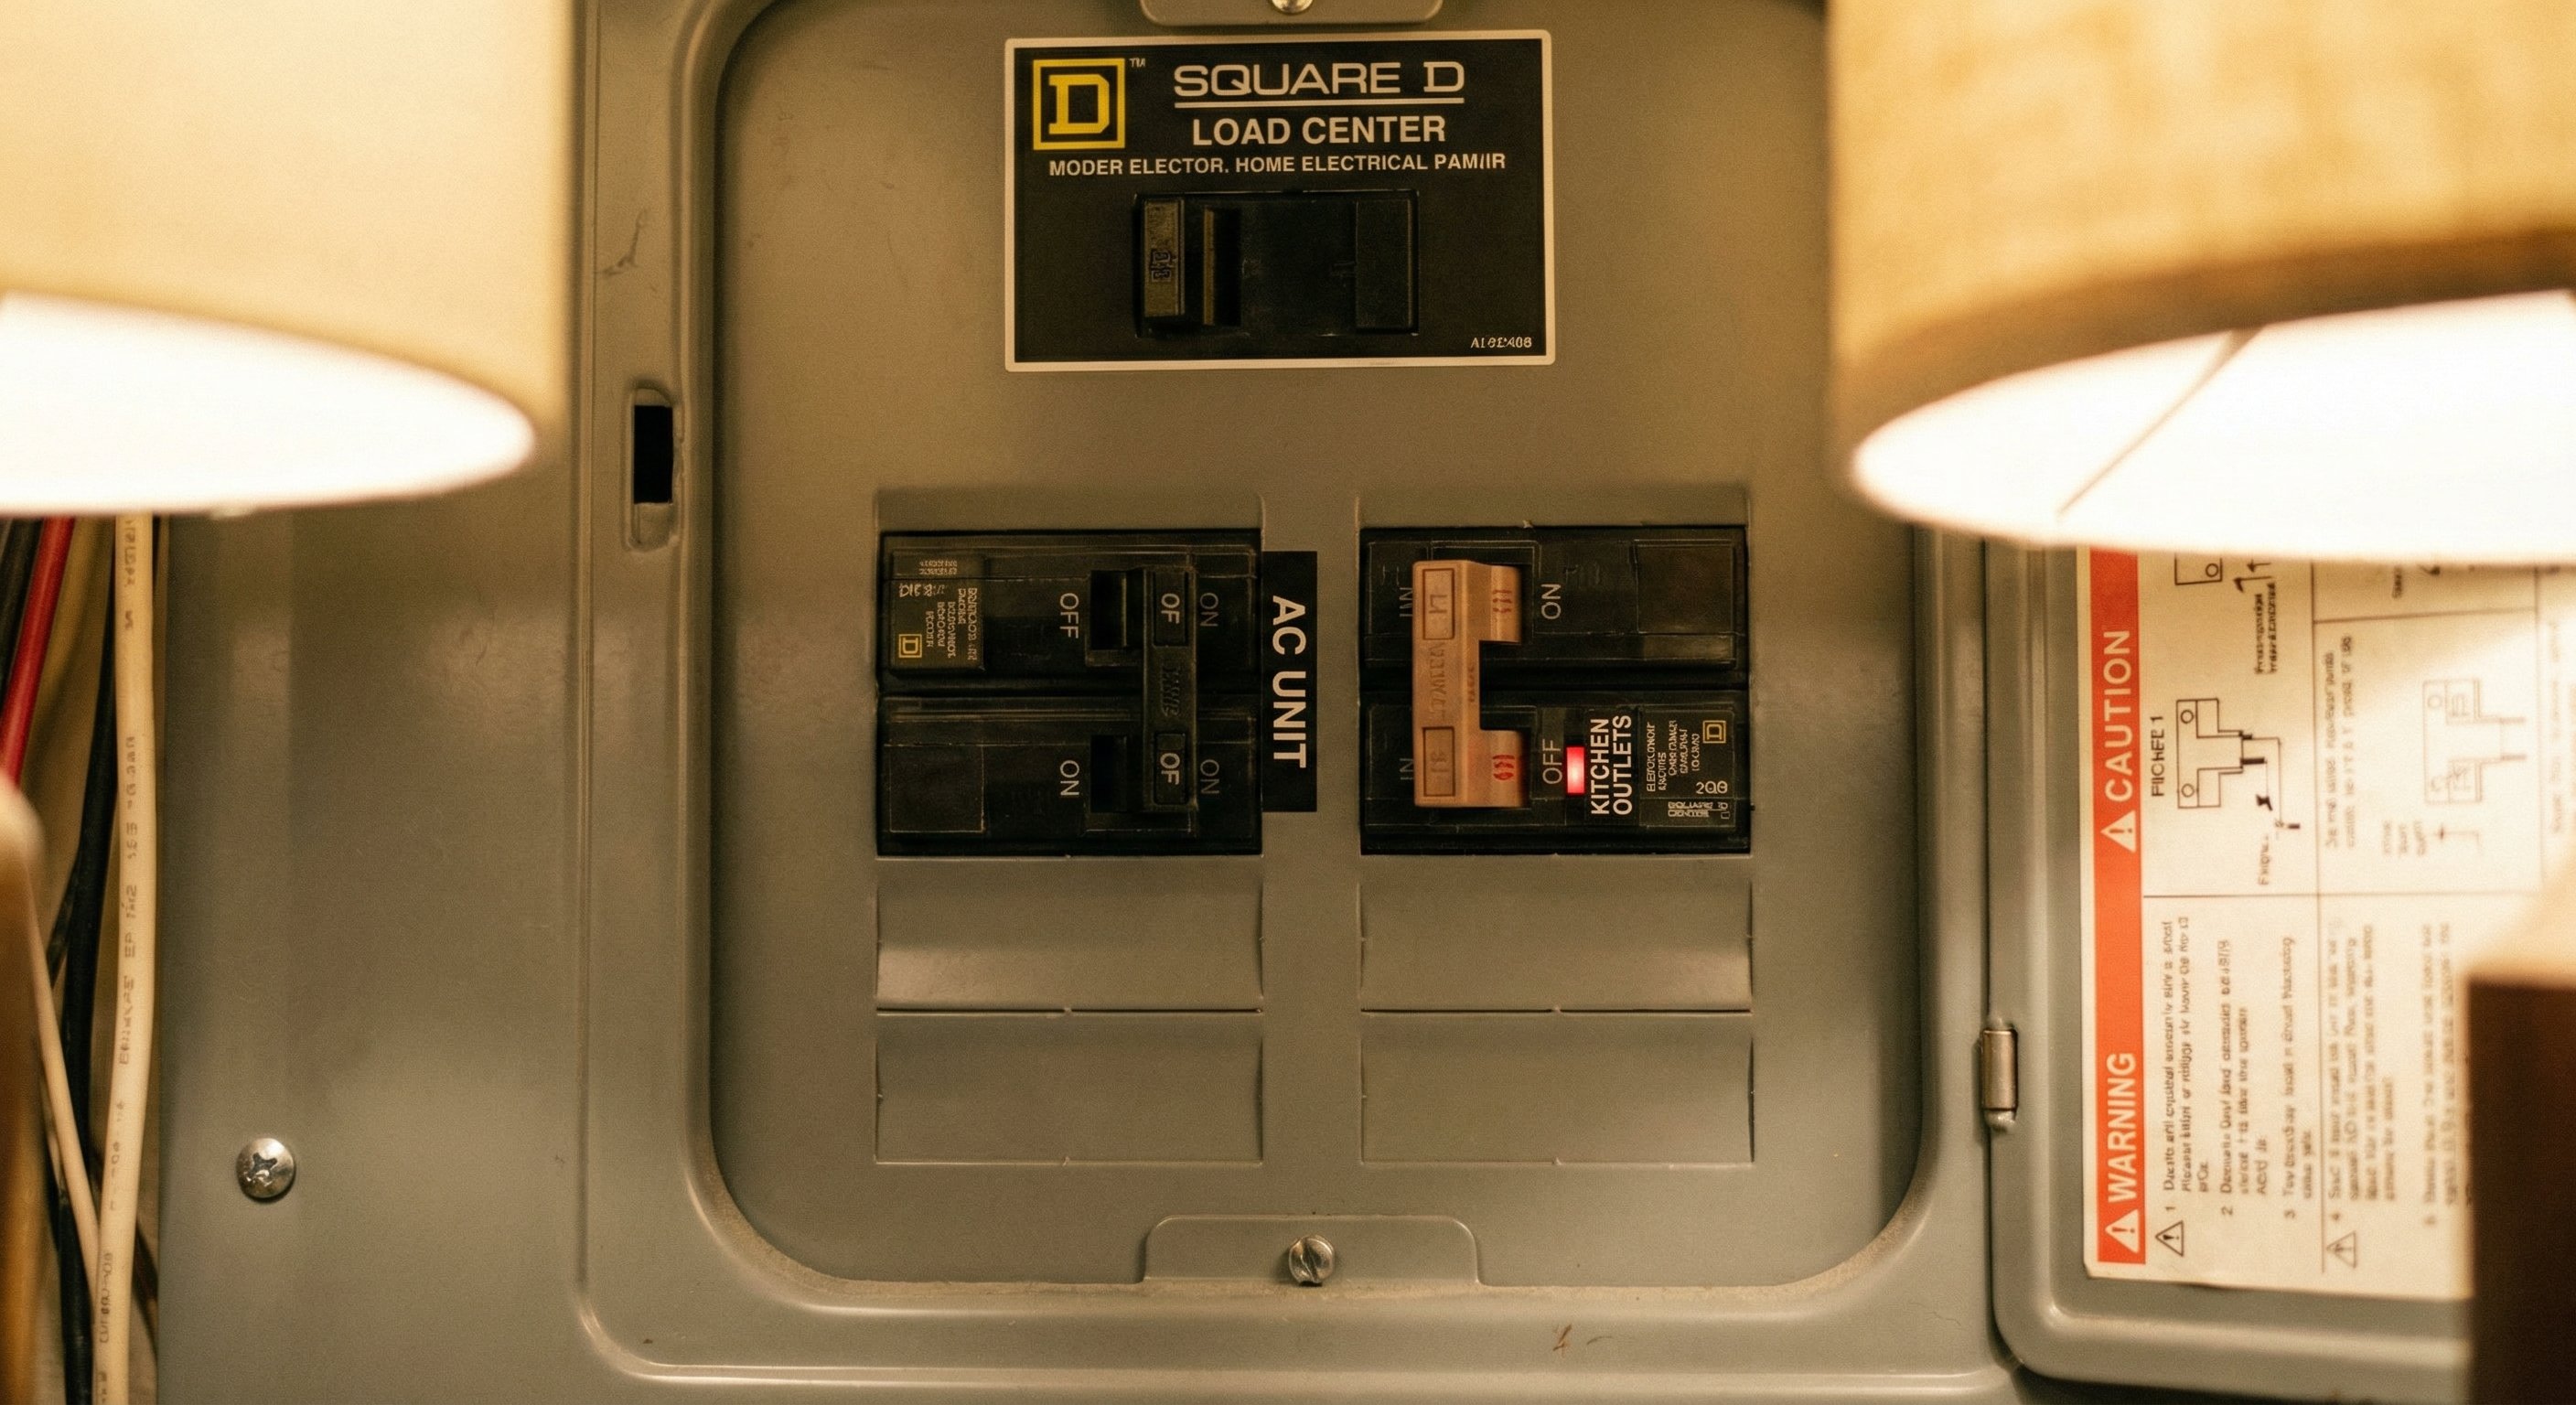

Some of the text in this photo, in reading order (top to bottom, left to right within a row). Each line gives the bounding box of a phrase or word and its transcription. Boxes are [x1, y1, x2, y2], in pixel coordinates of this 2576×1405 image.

[1174, 61, 1465, 97] SQUARE D
[1192, 115, 1446, 146] LOAD CENTER
[1049, 159, 1123, 176] MODER
[1235, 156, 1295, 173] HOME
[1302, 155, 1429, 172] ELECTRICAL
[1059, 593, 1080, 638] OFF
[1160, 593, 1181, 626] OF
[1199, 593, 1219, 627] ON
[1541, 584, 1562, 620] ON
[1272, 595, 1307, 769] AC UNIT
[2103, 630, 2134, 802] CAUTION
[1059, 760, 1080, 798] ON
[1160, 752, 1181, 786] OF
[1199, 758, 1220, 795] ON
[1542, 738, 1562, 785] OFF
[1590, 718, 1610, 815] KITCHEN
[1612, 714, 1633, 816] OUTLETS
[2106, 1052, 2137, 1204] WARNING
